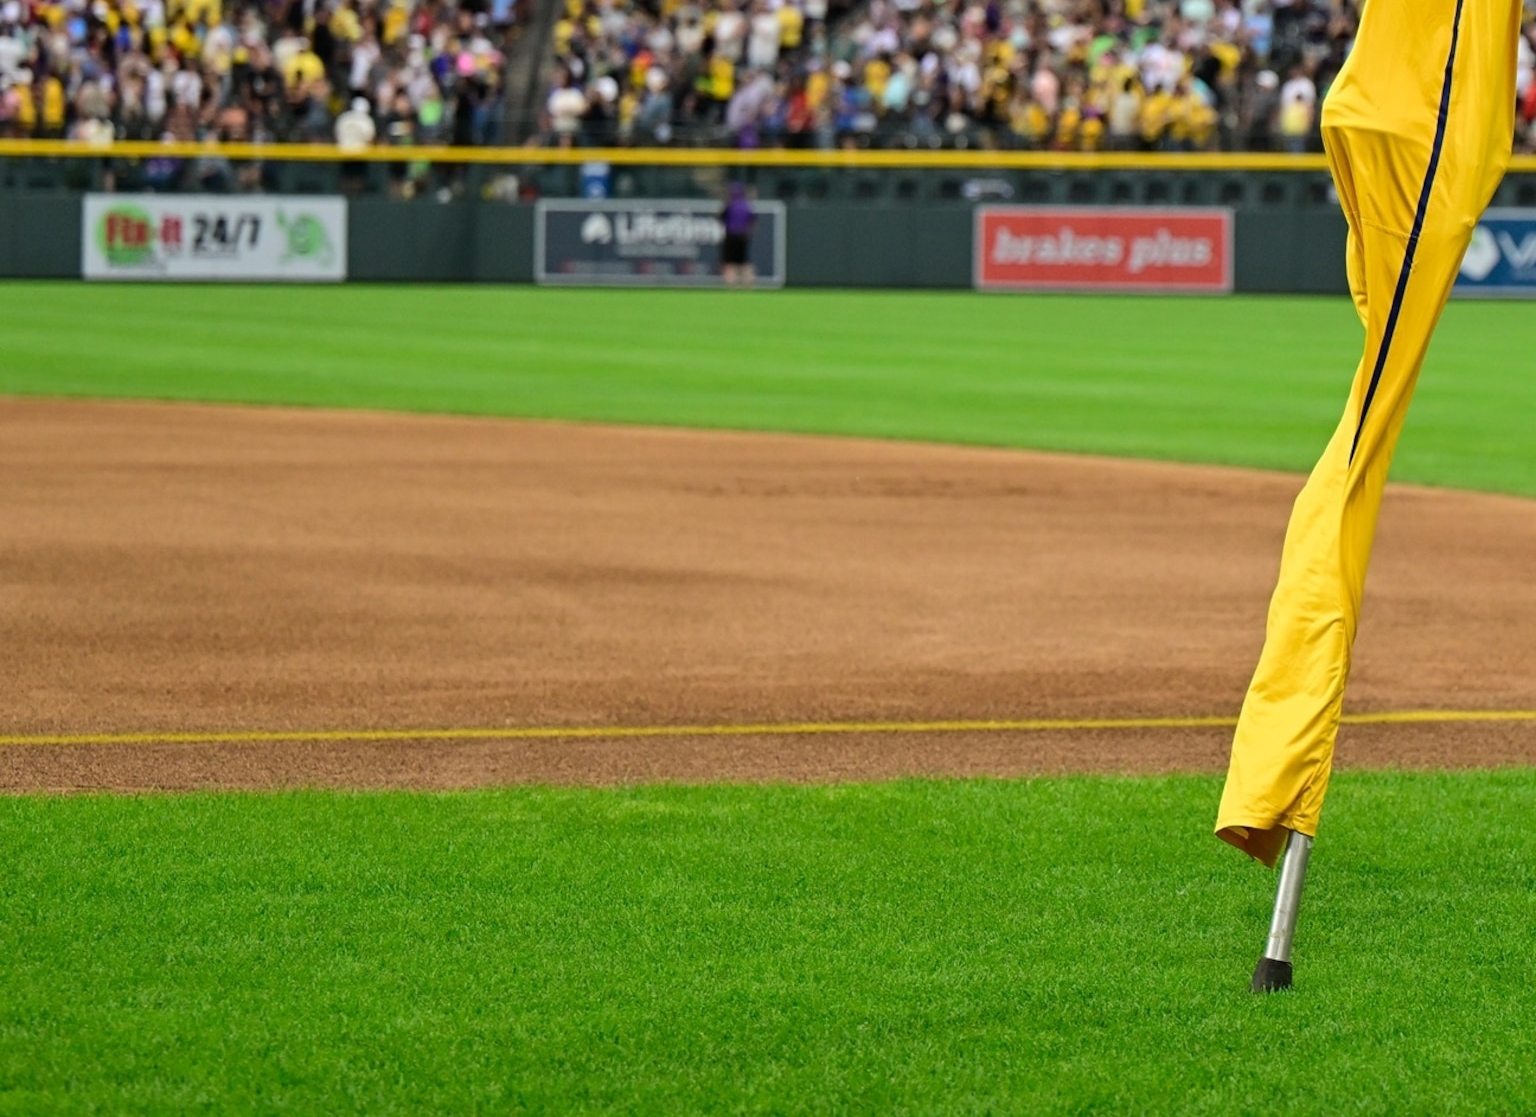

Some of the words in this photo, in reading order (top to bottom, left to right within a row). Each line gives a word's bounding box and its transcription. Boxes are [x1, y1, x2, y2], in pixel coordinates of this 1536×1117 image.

[191, 212, 261, 250] 24/7
[614, 210, 727, 246] Lifetim
[992, 224, 1124, 267] brakes
[1127, 226, 1212, 274] plus
